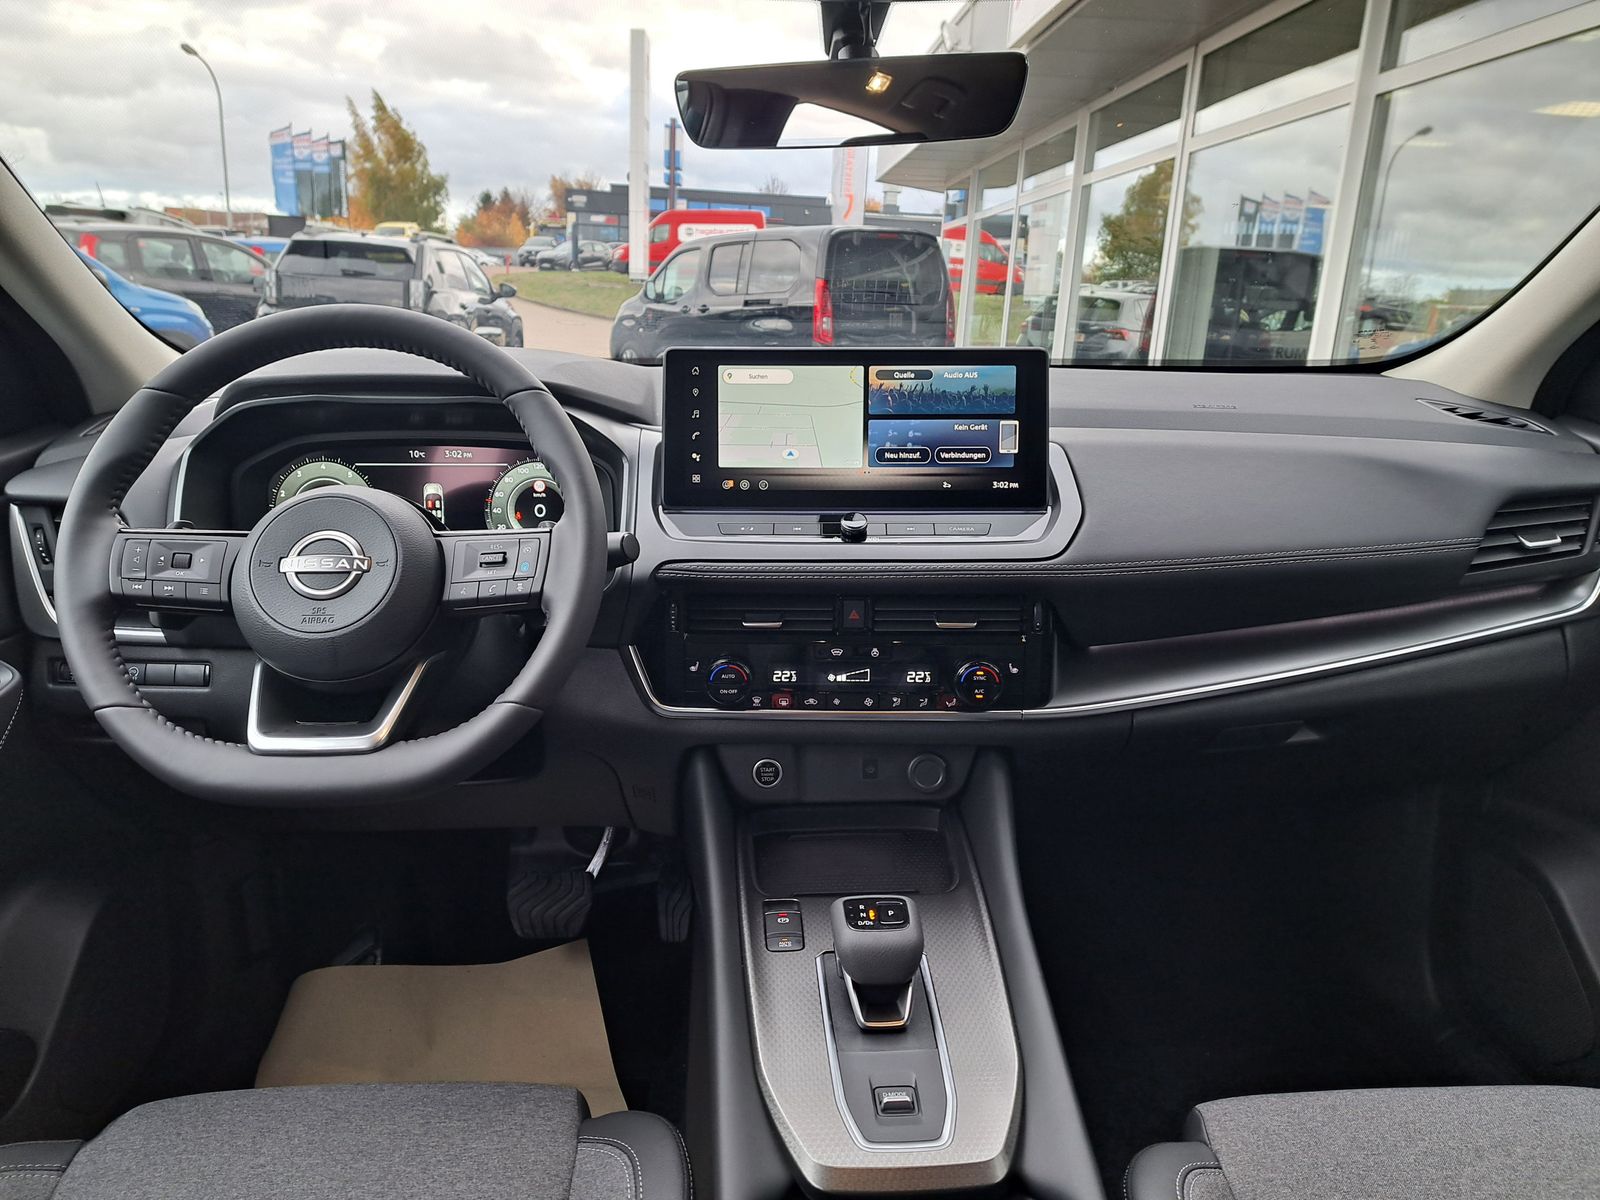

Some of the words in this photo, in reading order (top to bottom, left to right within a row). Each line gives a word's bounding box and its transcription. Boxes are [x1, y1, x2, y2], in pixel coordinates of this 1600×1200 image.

[893, 371, 915, 379] Quelle
[943, 371, 963, 379] Audio
[963, 371, 979, 379] AUS
[954, 423, 969, 431] Kein
[969, 423, 988, 431] Gerät
[444, 450, 462, 458] 3:02
[884, 451, 898, 459] Neu
[939, 451, 987, 460] Verbindungen
[991, 480, 1009, 489] 3:02
[534, 502, 547, 518] 0
[281, 556, 369, 571] NISSAN
[311, 606, 328, 615] SRS
[300, 616, 336, 626] AIRBAG
